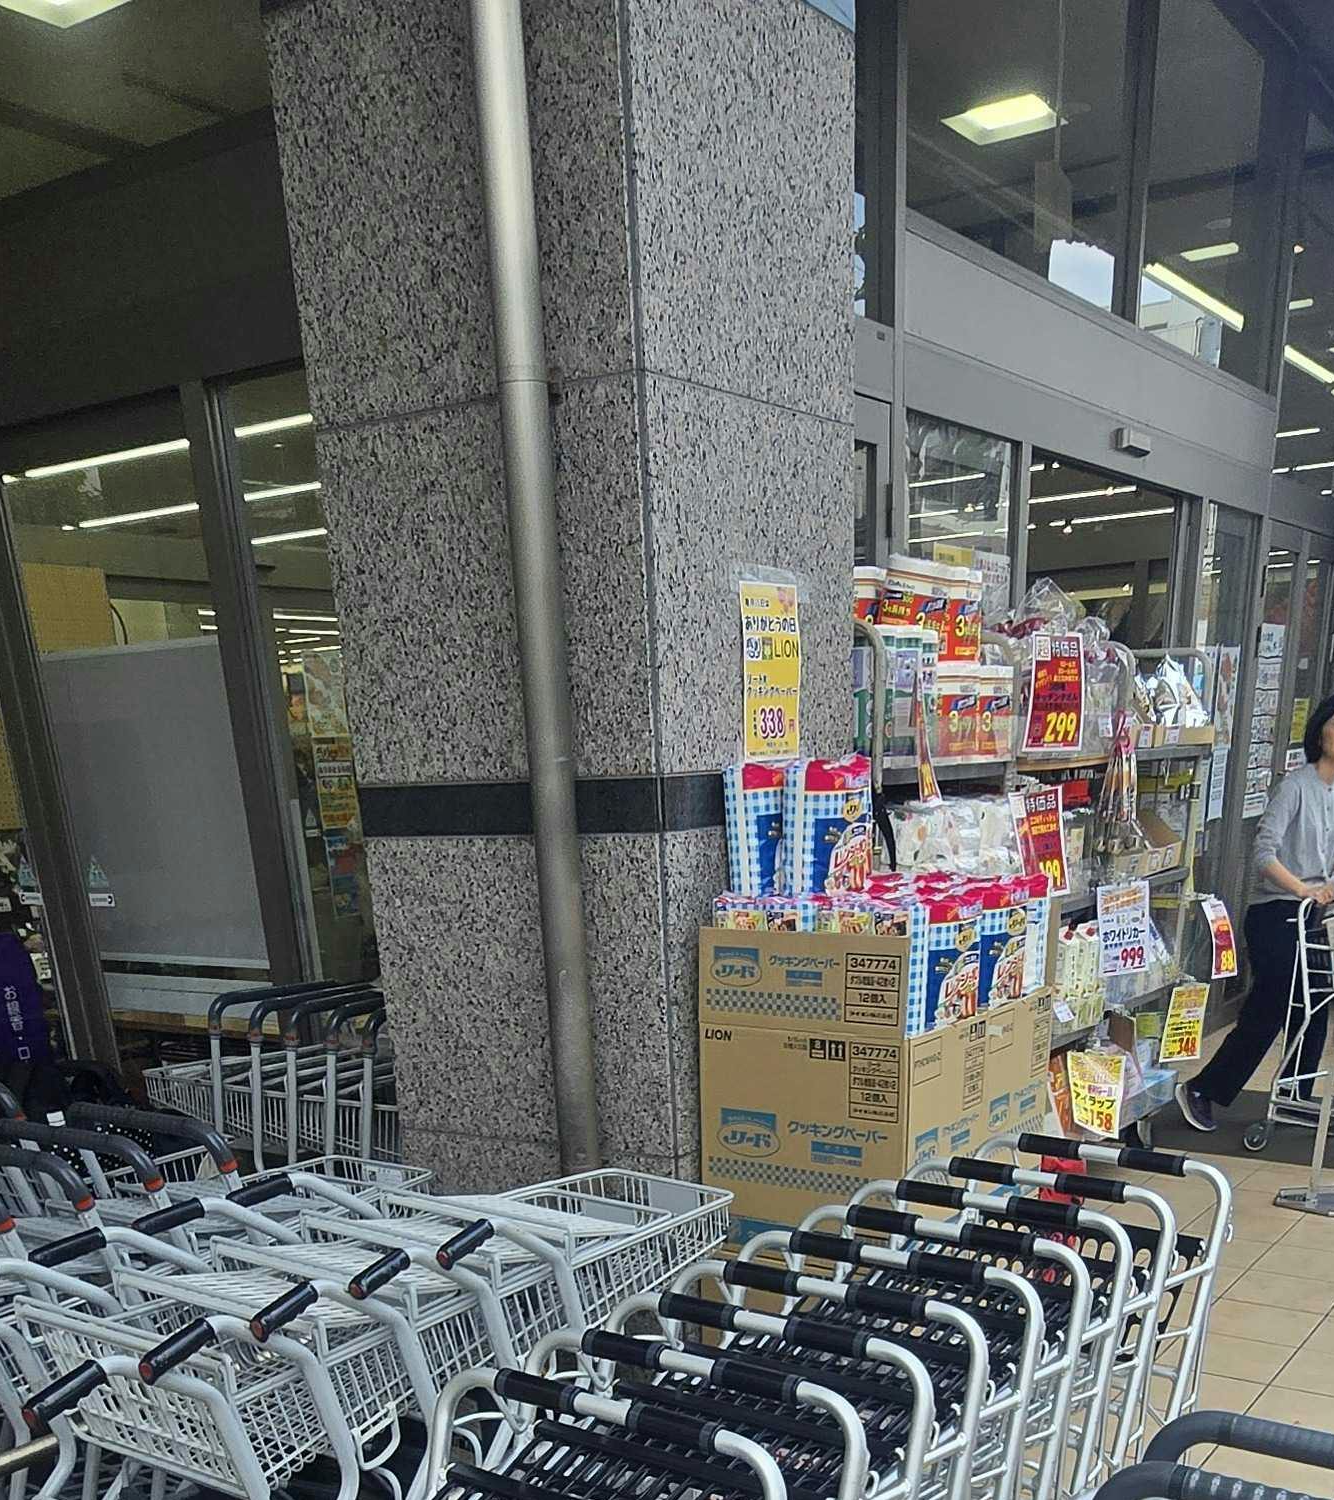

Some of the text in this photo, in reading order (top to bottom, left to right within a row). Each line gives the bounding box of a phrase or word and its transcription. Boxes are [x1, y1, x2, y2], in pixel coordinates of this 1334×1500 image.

[744, 616, 797, 633] ありがとうの日
[773, 640, 799, 658] LION
[760, 707, 786, 738] 338
[1043, 711, 1077, 742] 299
[1102, 927, 1146, 943] ホワイトリカー
[768, 955, 840, 968] クッキングペーパー
[850, 957, 896, 970] 347774
[1121, 945, 1144, 968] 999
[705, 1029, 732, 1041] LION
[852, 1045, 897, 1059] 347774
[1073, 1089, 1116, 1109] アイラップ
[1090, 1109, 1113, 1130] 158
[723, 1129, 772, 1149] リード
[786, 1120, 889, 1145] クッキングペーパー
